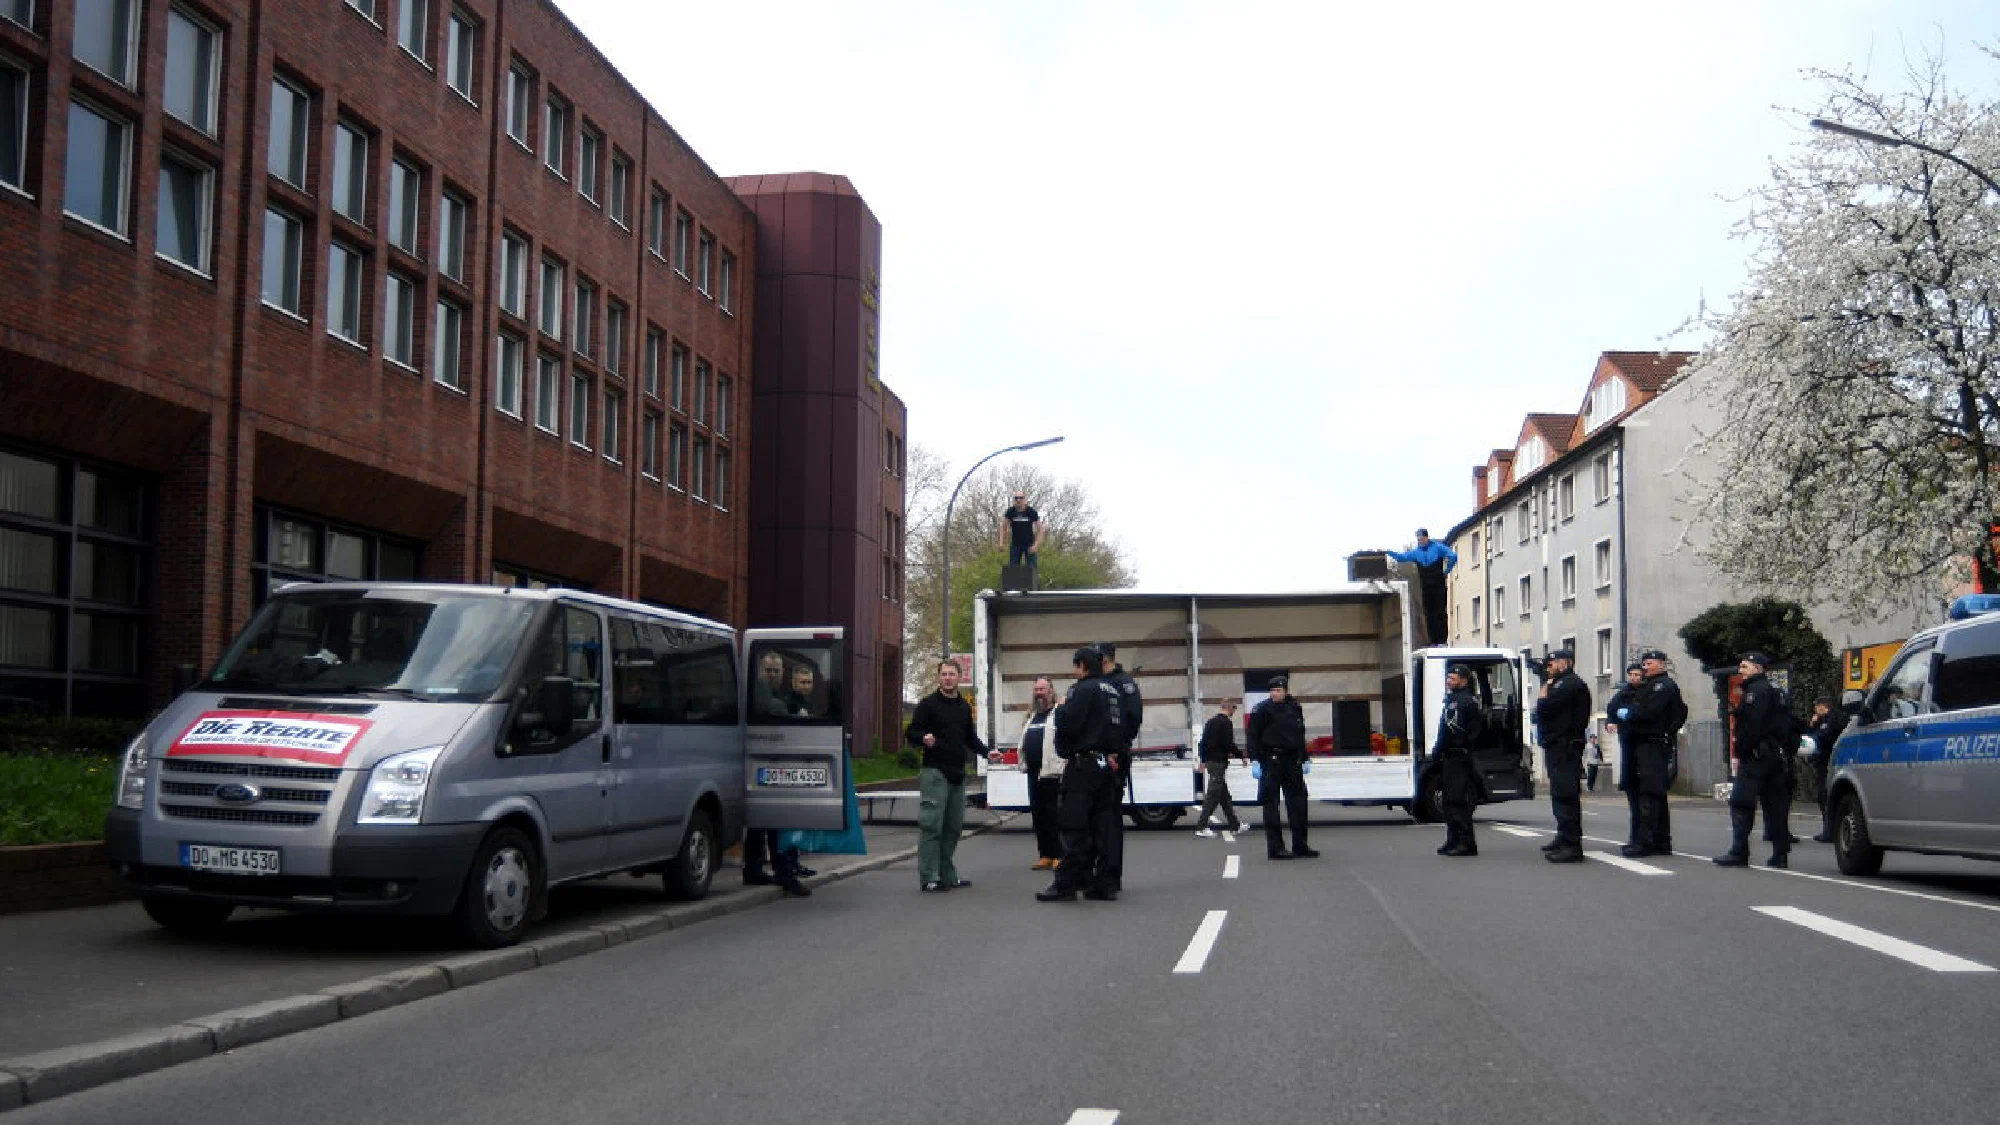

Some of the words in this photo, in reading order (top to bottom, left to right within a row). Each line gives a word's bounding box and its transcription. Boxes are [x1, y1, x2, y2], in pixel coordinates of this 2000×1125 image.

[242, 720, 353, 743] RECHTE
[192, 847, 209, 866] DO
[220, 850, 238, 867] MG
[242, 850, 278, 871] 4530
